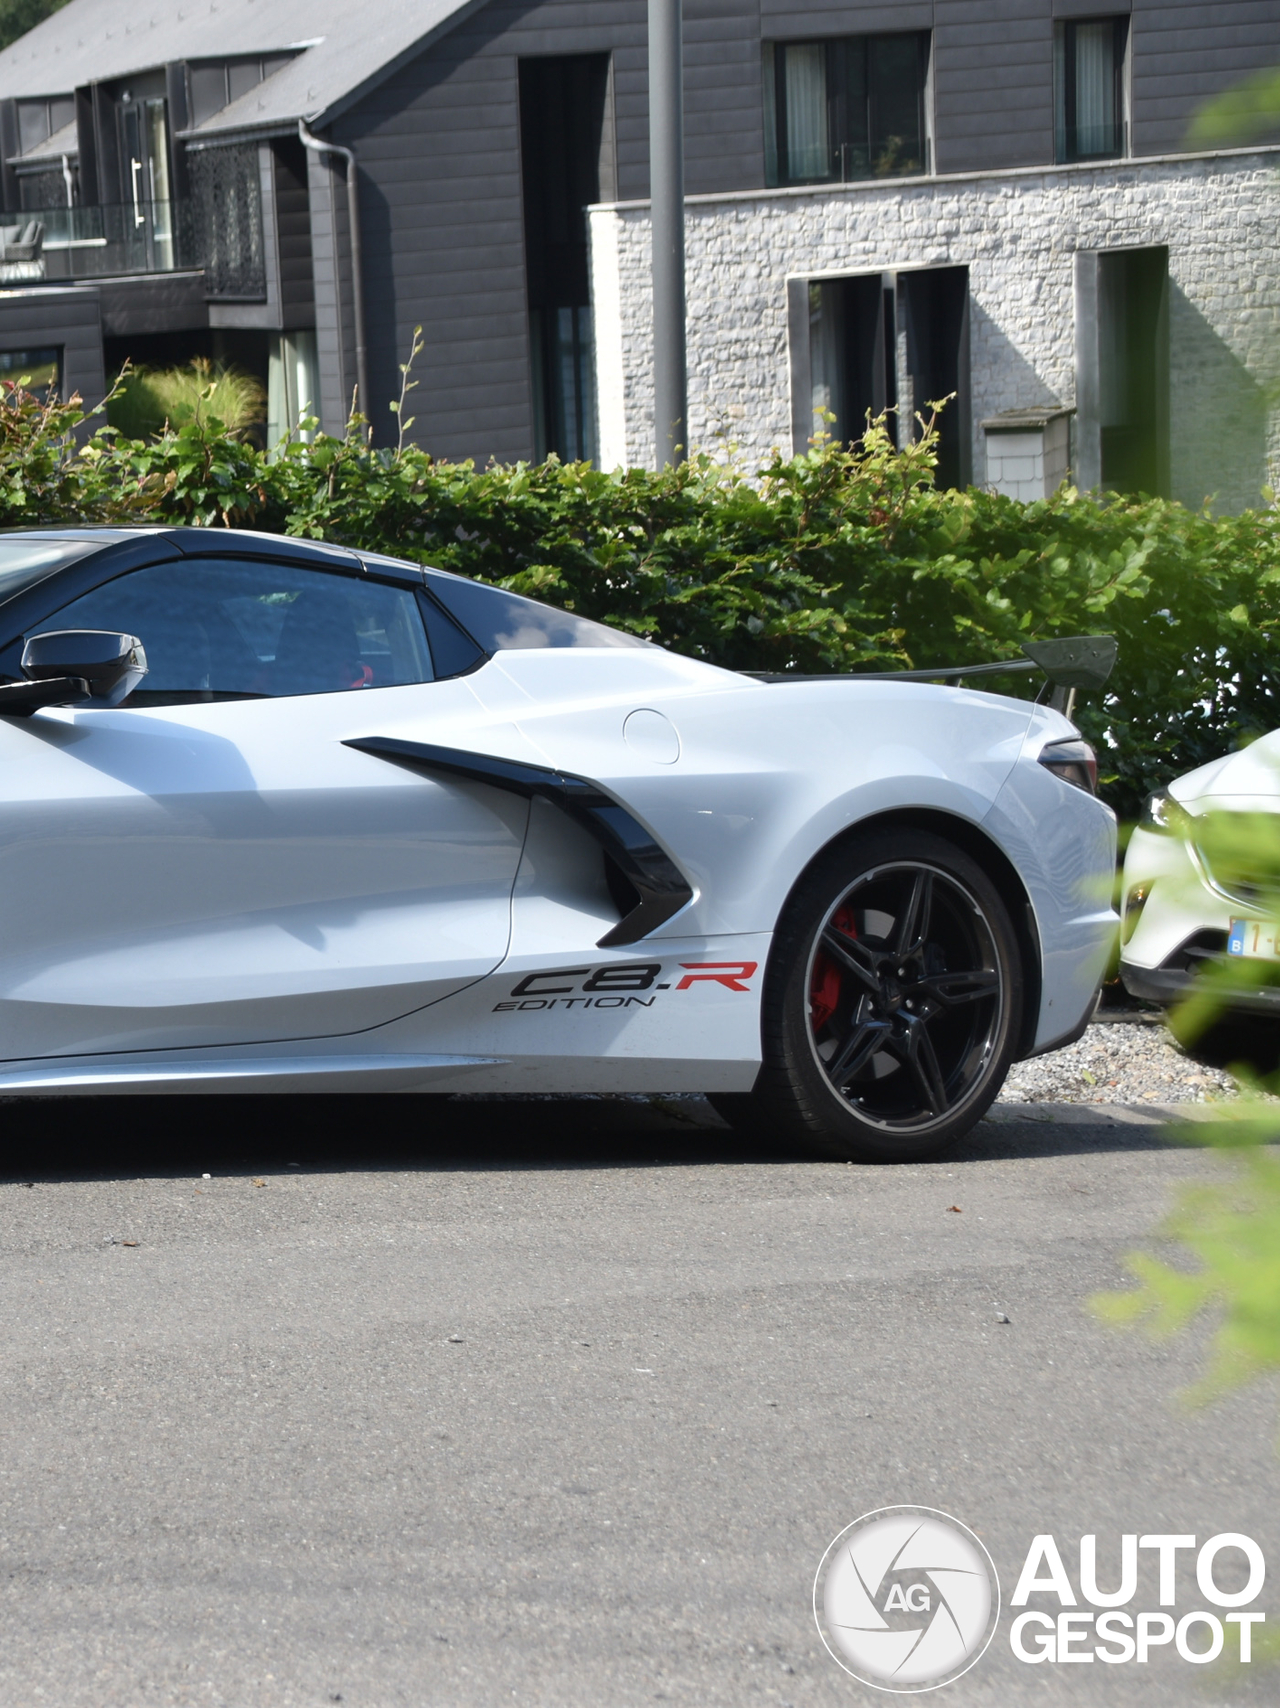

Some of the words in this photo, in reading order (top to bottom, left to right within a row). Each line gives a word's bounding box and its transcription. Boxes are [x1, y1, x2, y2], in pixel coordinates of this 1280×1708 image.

[1231, 939, 1242, 952] B
[510, 961, 758, 997] C8.R
[491, 996, 656, 1012] EDITION
